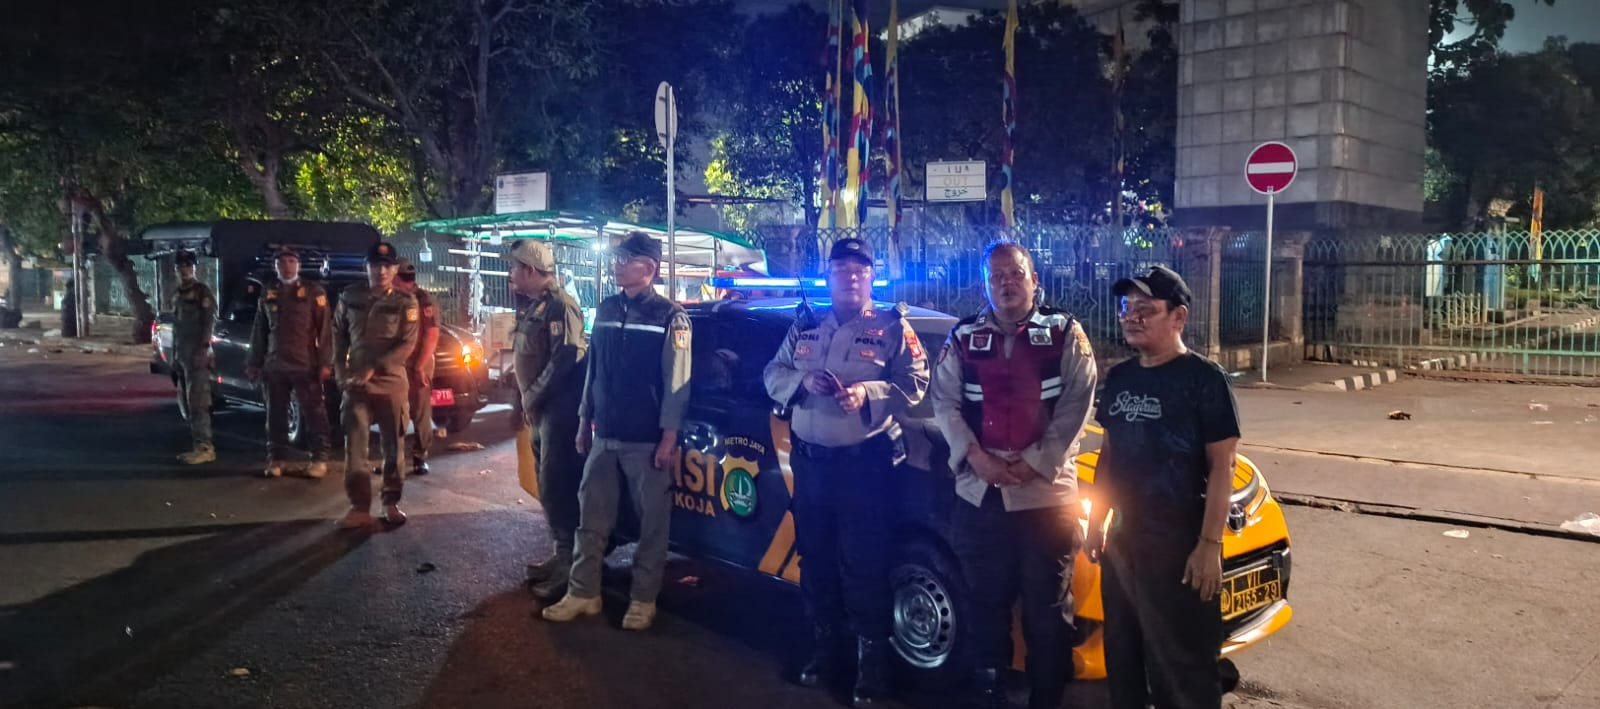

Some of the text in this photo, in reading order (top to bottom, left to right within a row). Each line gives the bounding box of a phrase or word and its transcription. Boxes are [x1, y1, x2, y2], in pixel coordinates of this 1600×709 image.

[724, 437, 766, 455] METRO JAYA
[674, 492, 716, 518] KOJA
